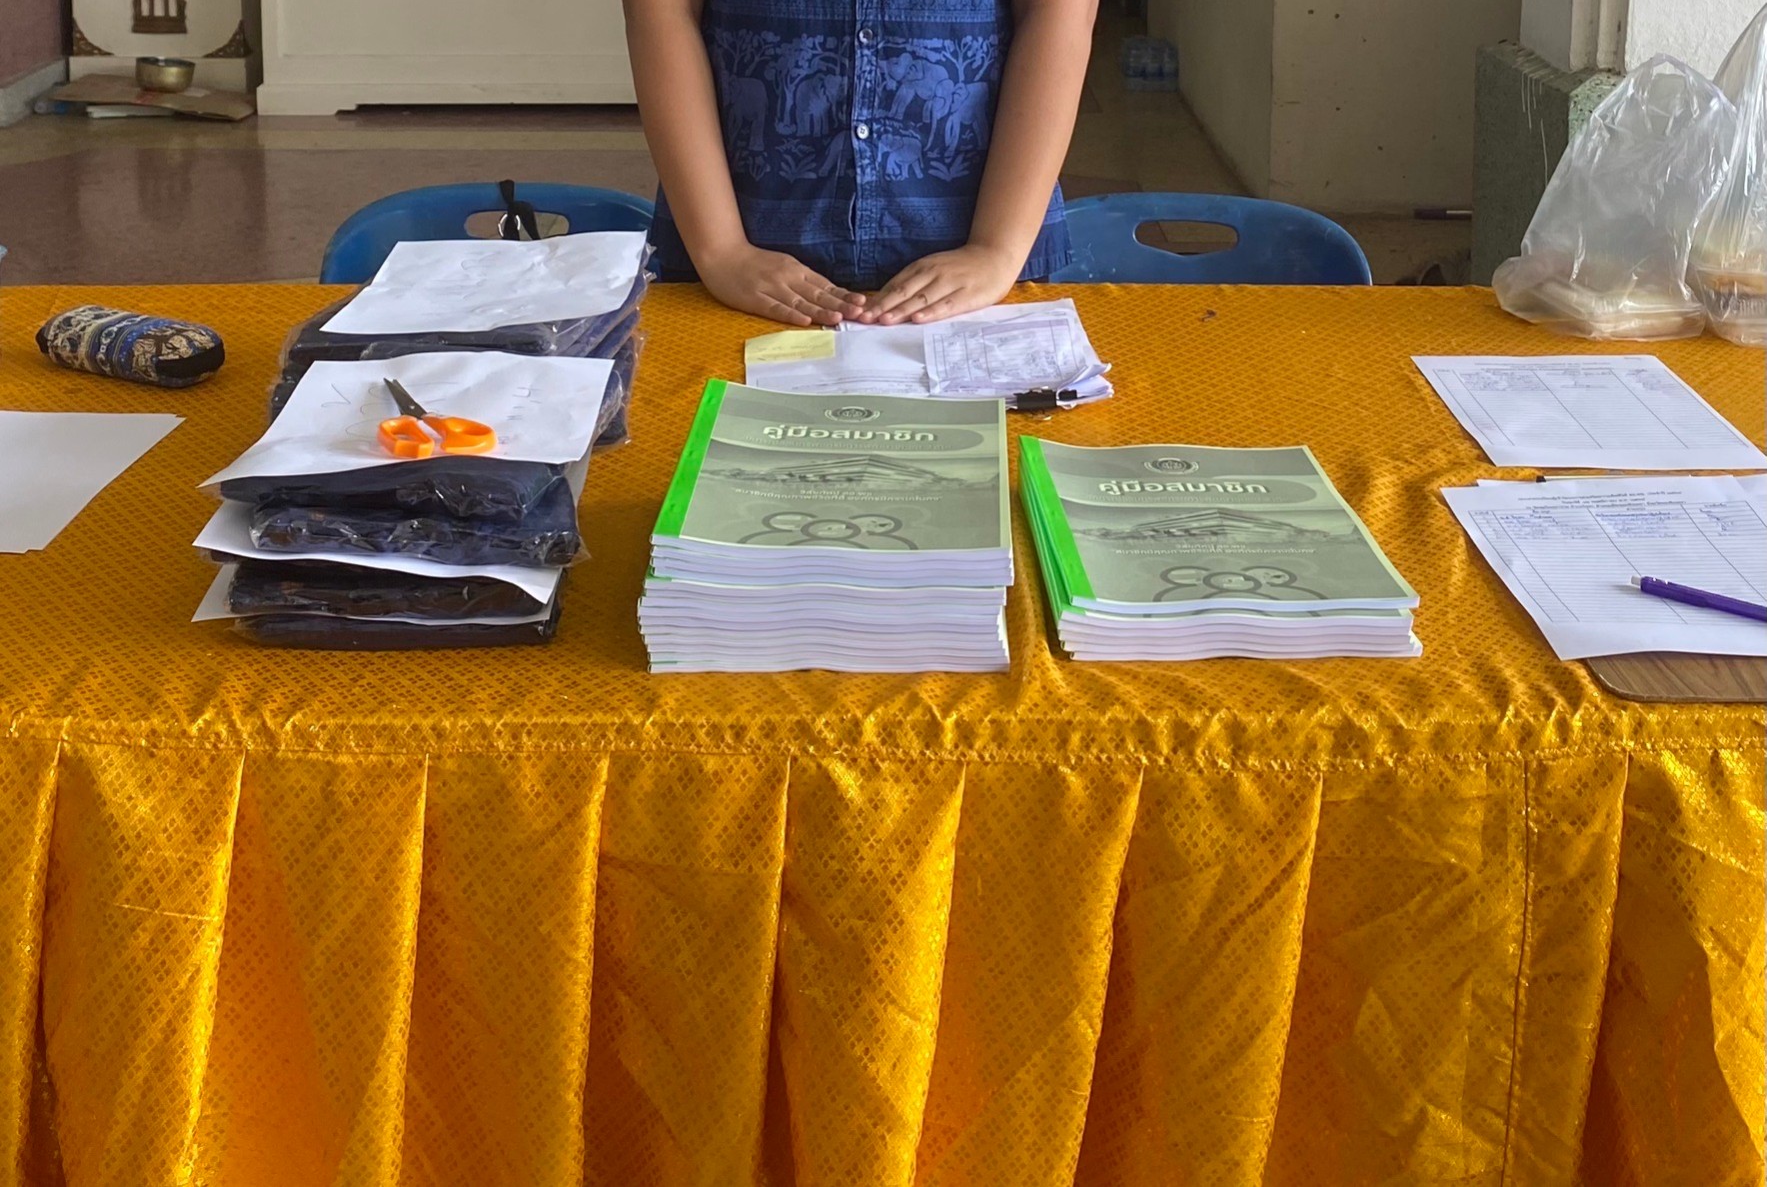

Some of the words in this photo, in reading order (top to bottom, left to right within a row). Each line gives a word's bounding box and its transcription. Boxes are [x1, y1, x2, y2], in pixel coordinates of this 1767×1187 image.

[763, 424, 937, 442] คู่มือสมาชิก
[1098, 479, 1269, 495] คู่มือสมาชิก
